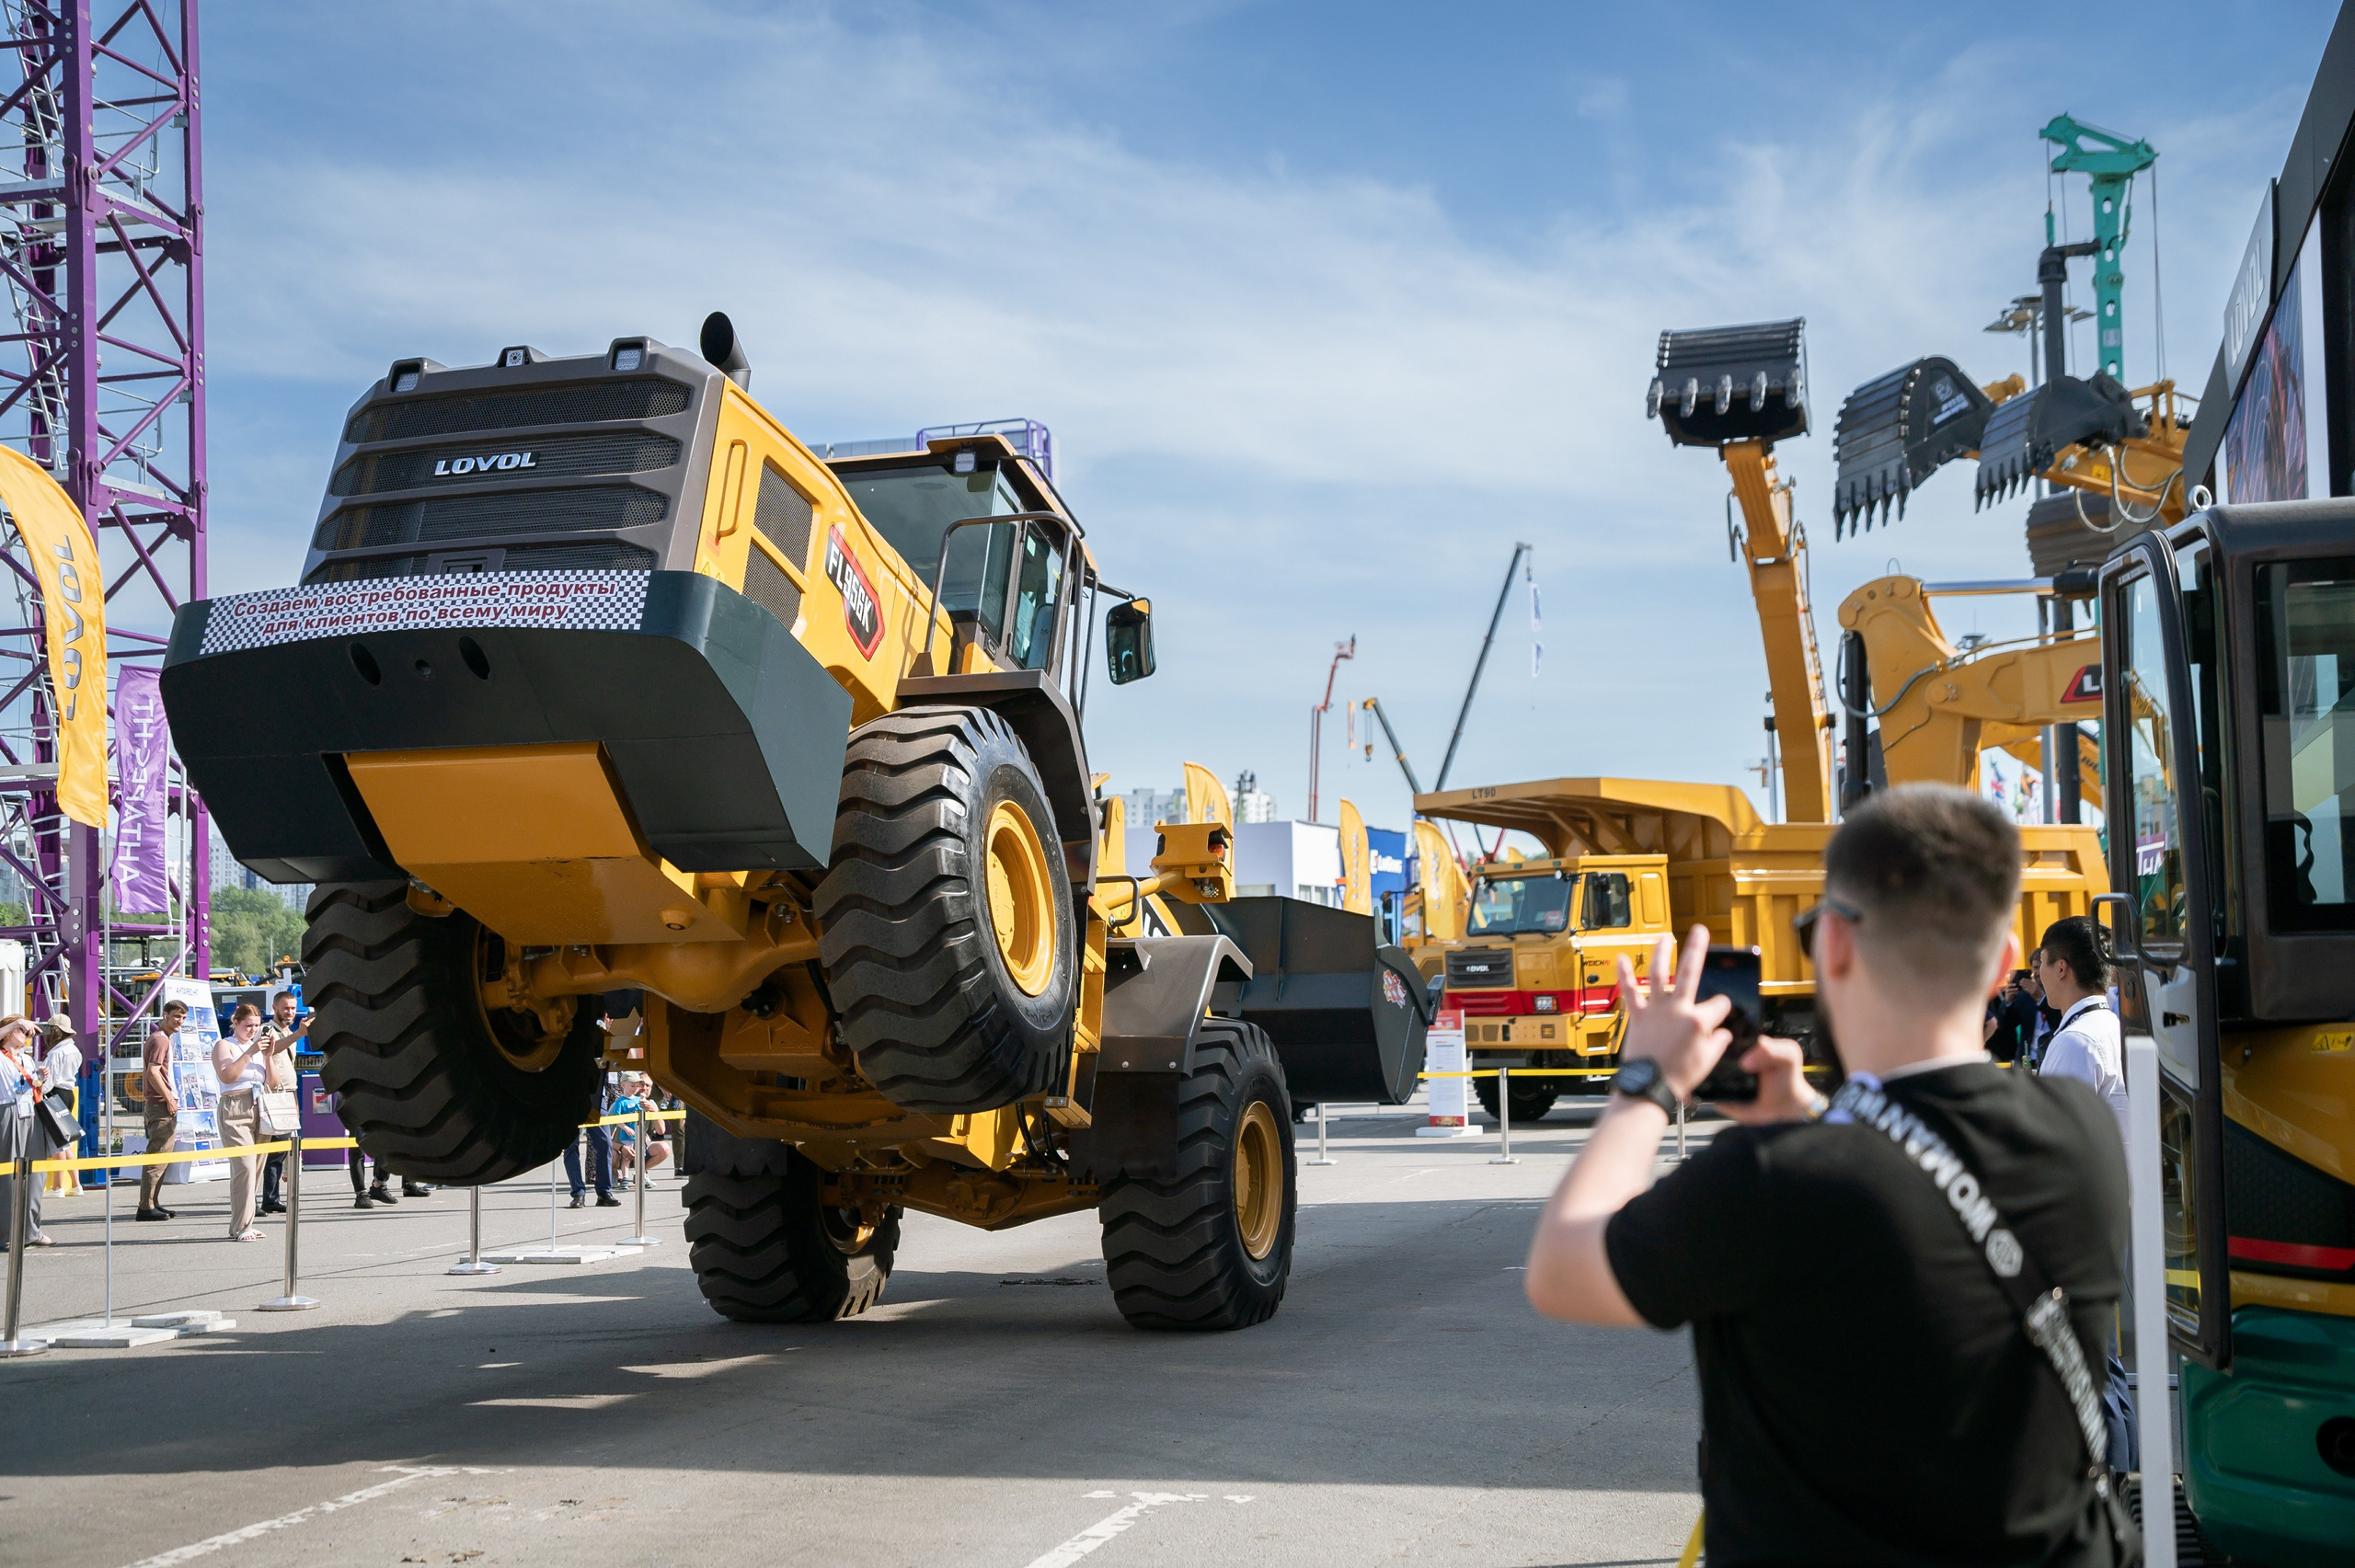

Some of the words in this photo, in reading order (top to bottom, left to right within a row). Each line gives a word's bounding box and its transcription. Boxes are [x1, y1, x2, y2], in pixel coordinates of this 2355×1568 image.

[2230, 238, 2265, 369] LOVOL
[434, 452, 536, 475] LOVOL
[234, 597, 317, 617] Создаем
[324, 584, 500, 607] востребованные
[507, 582, 616, 599] продукты
[828, 541, 873, 634] FL956K
[52, 534, 84, 722] LOVOL
[261, 619, 298, 635] для
[304, 610, 398, 630] клиентов
[405, 608, 431, 622] по
[437, 605, 505, 621] всему
[511, 603, 569, 620] миру
[1472, 786, 1497, 800] LT90
